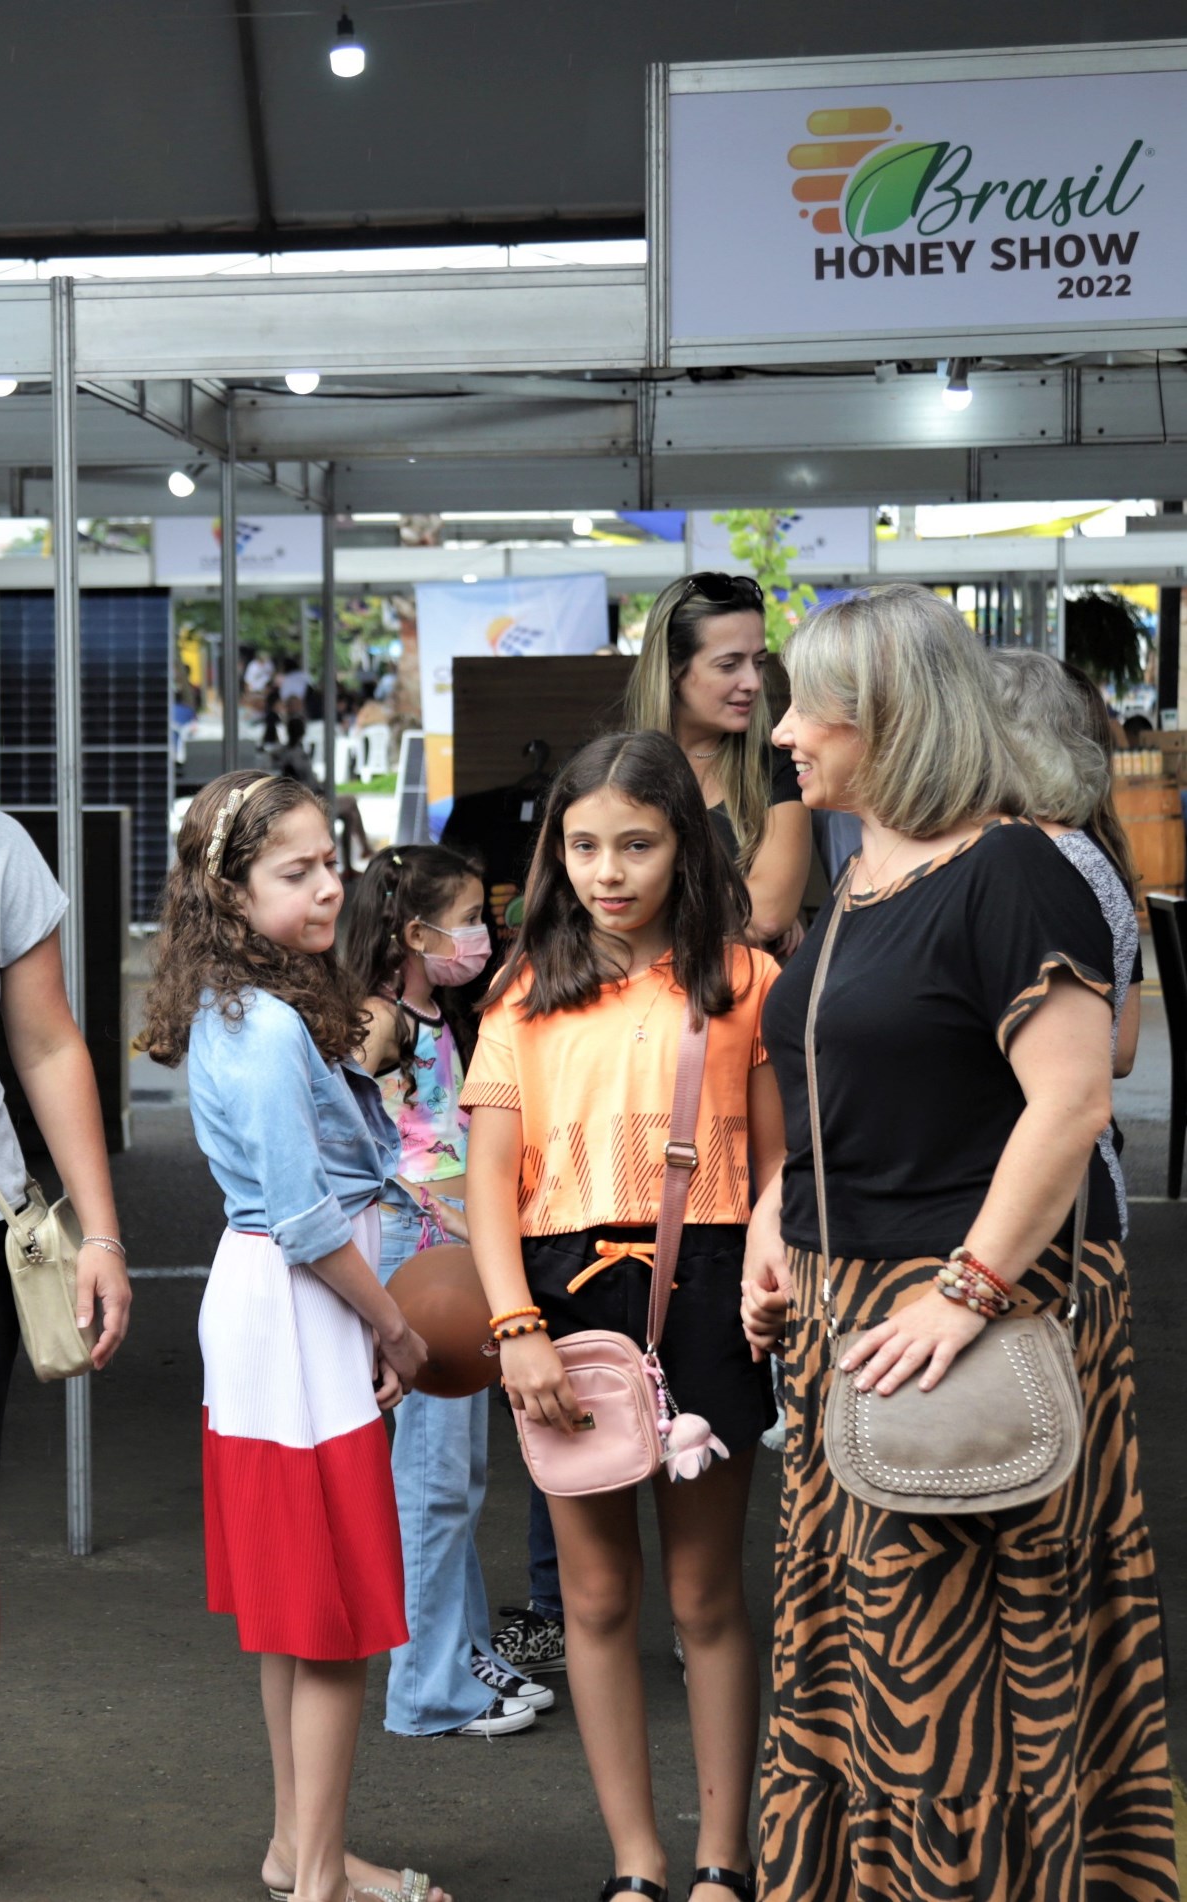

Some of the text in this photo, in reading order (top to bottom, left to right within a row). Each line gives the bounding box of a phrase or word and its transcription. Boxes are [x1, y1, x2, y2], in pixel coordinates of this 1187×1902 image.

[910, 139, 1145, 237] Brasil
[813, 231, 1140, 281] HONEY SHOW
[1056, 274, 1133, 300] 2022
